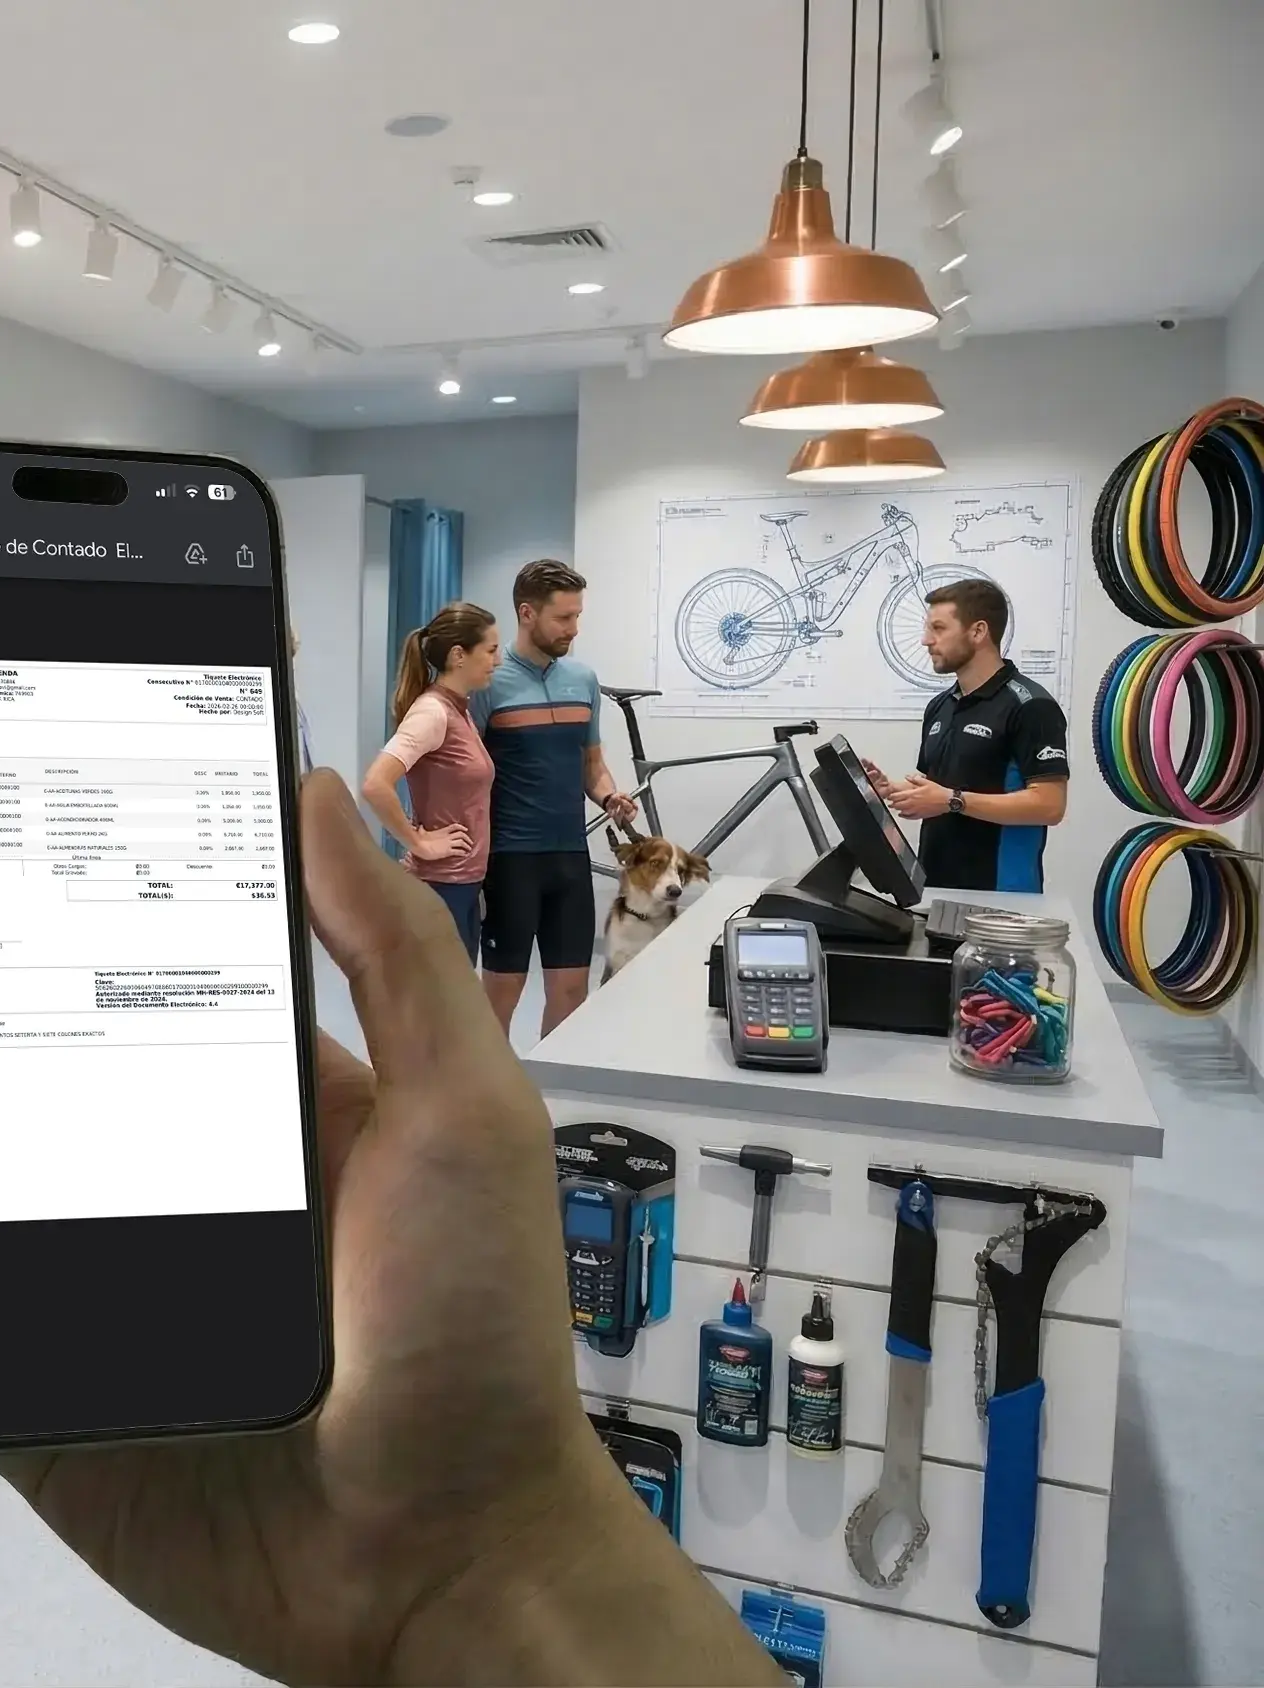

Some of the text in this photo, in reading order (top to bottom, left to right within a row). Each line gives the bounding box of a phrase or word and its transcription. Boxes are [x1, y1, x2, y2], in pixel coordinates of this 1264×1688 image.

[213, 486, 228, 499] 61
[6, 538, 28, 556] de
[32, 538, 107, 558] Contado
[117, 542, 144, 560] El...
